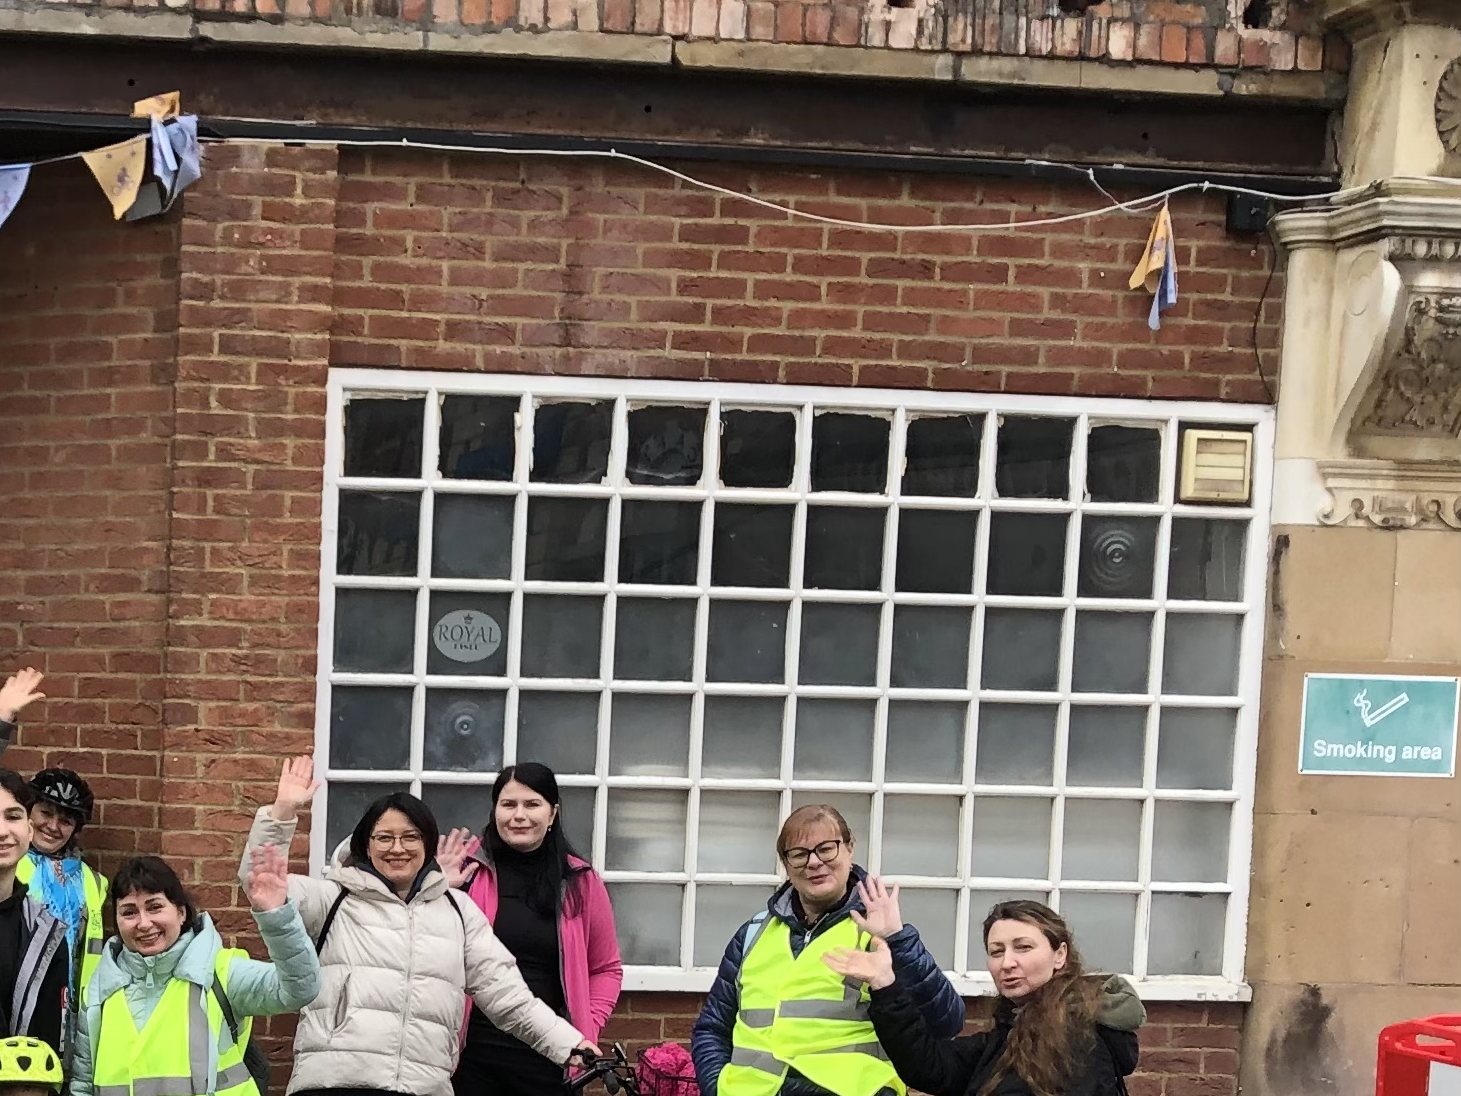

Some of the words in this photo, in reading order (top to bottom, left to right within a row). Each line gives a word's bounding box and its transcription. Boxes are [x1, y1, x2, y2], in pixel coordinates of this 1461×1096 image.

[438, 624, 497, 643] ROYAL
[1313, 739, 1397, 764] Smoking
[1401, 746, 1443, 761] area
